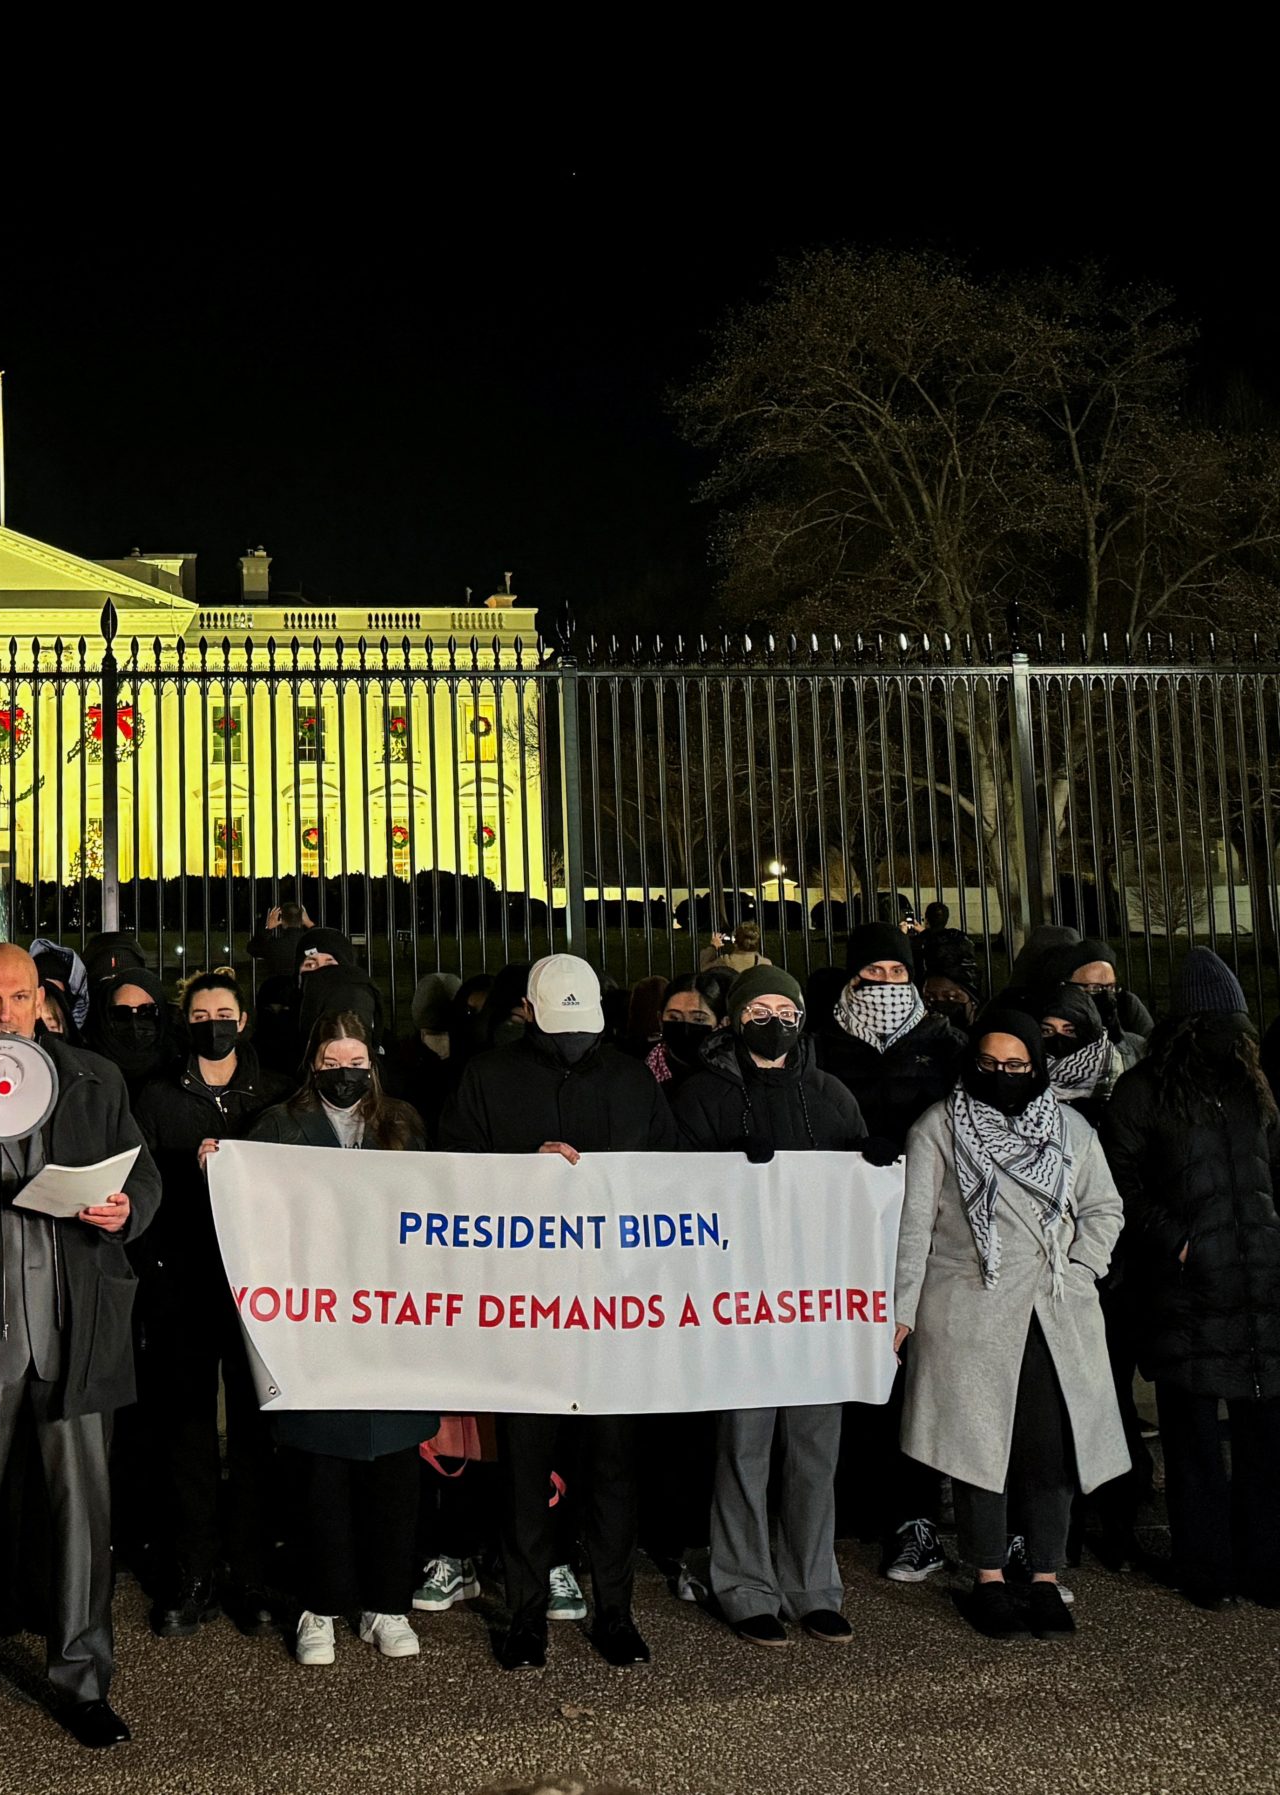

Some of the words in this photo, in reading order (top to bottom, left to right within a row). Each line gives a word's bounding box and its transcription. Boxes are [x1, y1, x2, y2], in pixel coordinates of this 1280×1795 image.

[399, 1212, 607, 1249] PRESIDENT
[619, 1212, 729, 1251] BIDEN,
[351, 1290, 464, 1327] STAFF
[478, 1295, 666, 1330] DEMANDS
[679, 1294, 701, 1327] A
[713, 1289, 887, 1325] CEASEFIRE
